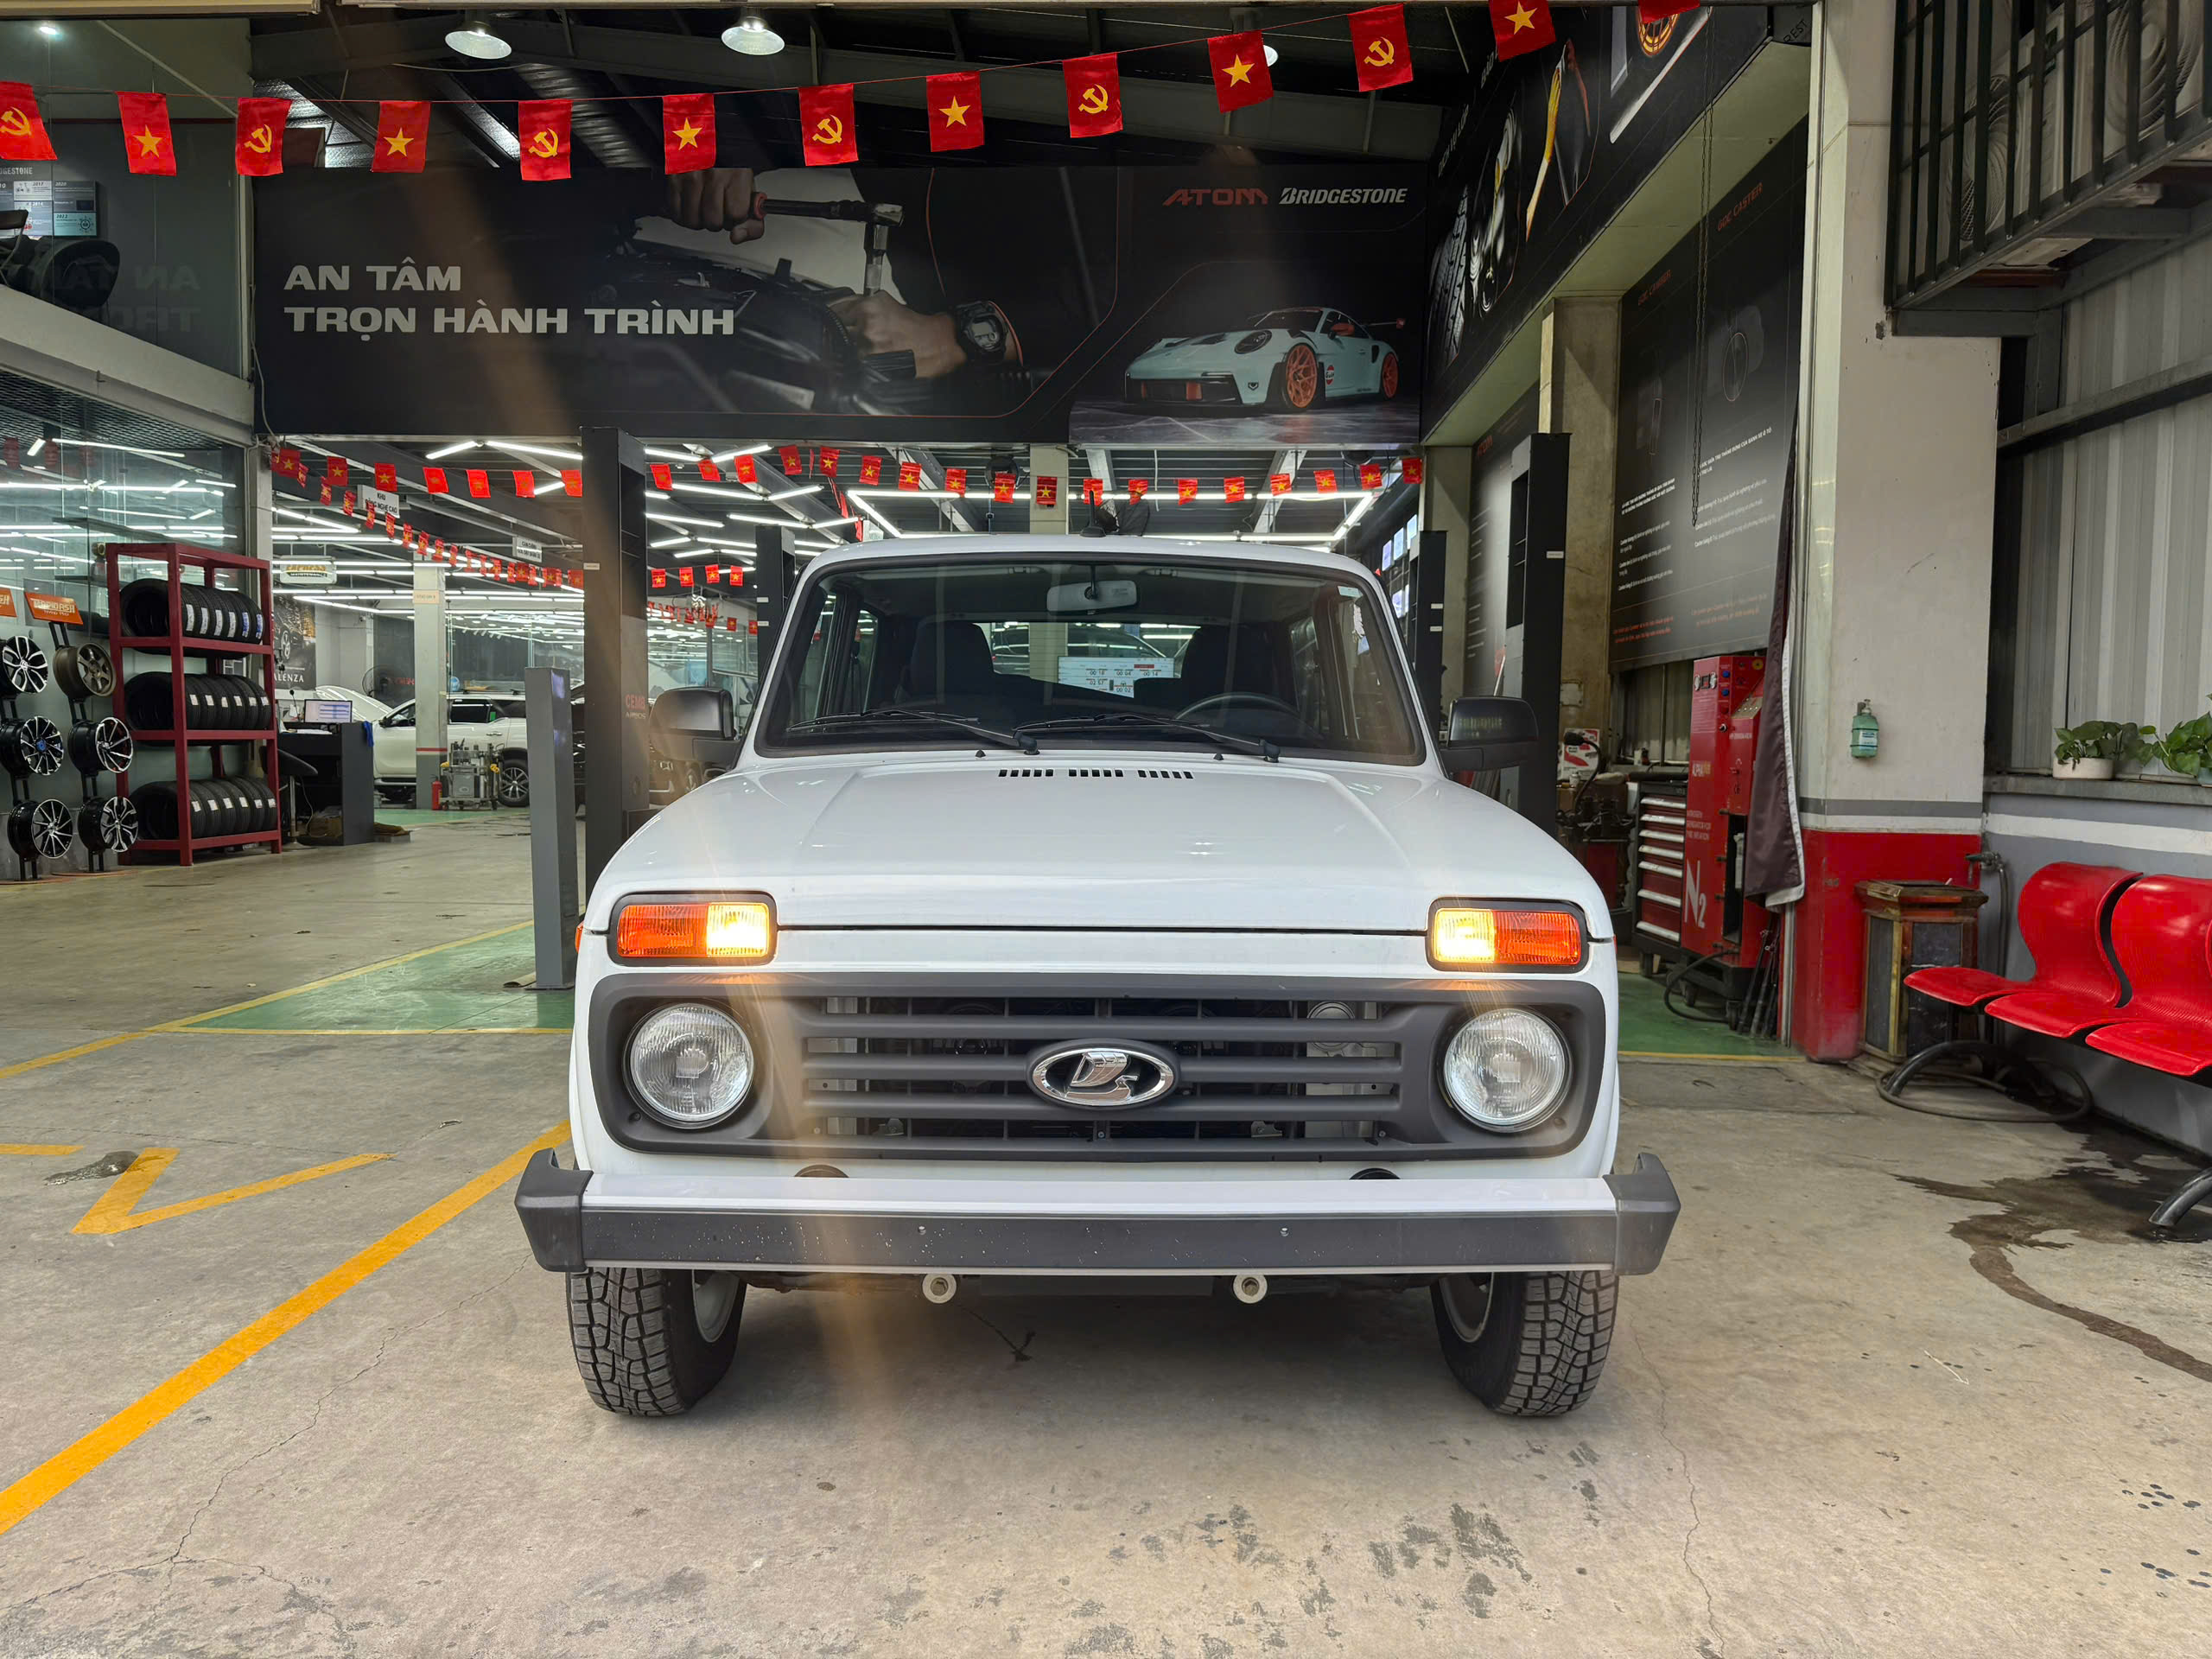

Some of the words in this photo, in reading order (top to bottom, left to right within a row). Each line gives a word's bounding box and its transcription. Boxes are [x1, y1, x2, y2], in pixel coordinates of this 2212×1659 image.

[1163, 188, 1268, 207] ATOM
[1279, 188, 1408, 205] BRIDGESTONE
[284, 265, 350, 290] AN
[366, 257, 461, 291] TÂM
[284, 307, 416, 341] TRỌN
[434, 299, 568, 334] HÀNH
[584, 300, 734, 334] TRÌNH
